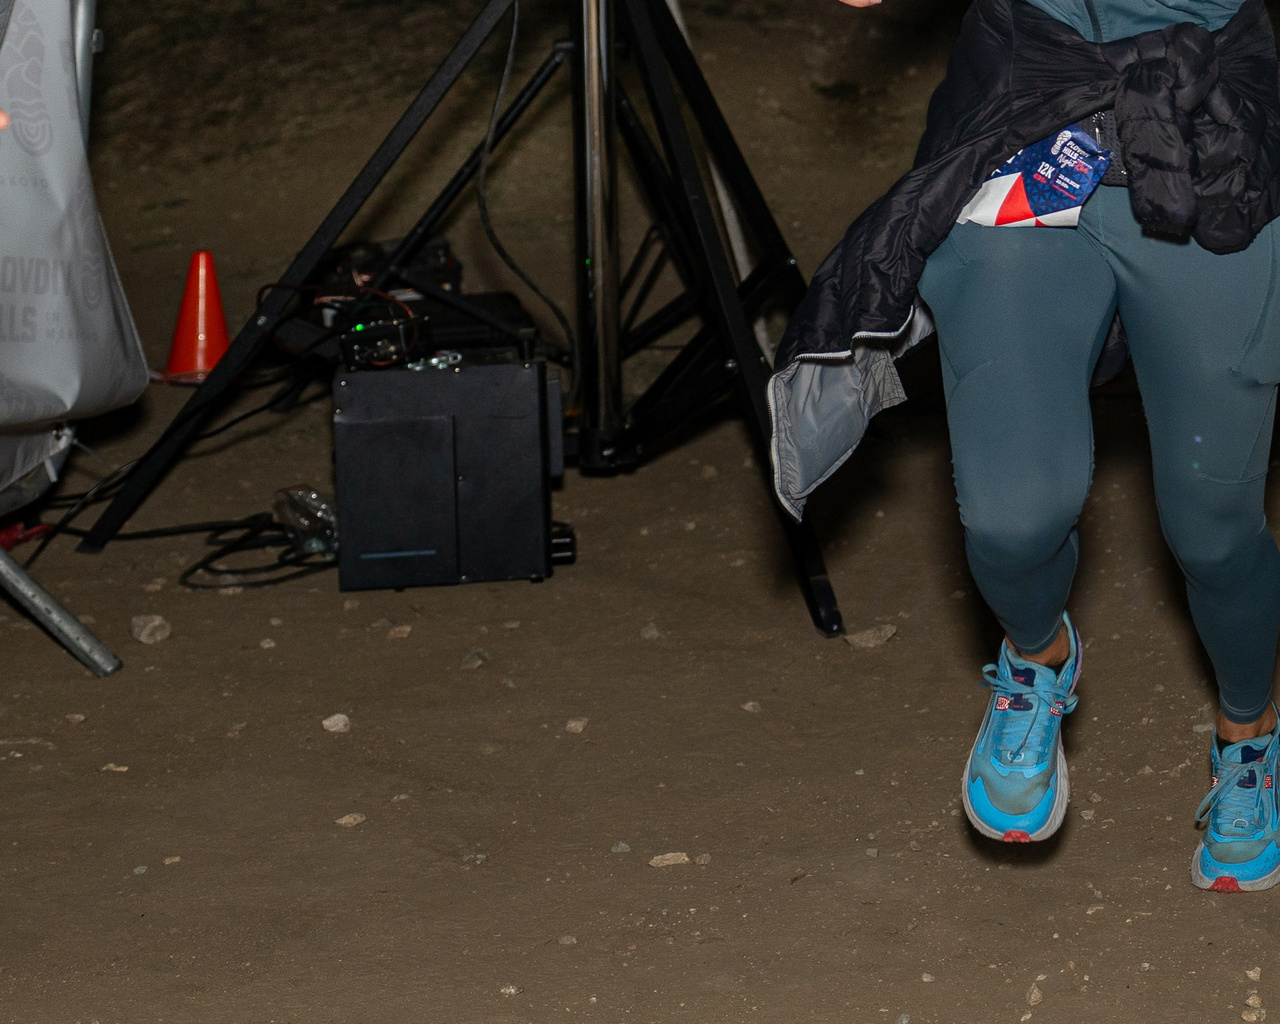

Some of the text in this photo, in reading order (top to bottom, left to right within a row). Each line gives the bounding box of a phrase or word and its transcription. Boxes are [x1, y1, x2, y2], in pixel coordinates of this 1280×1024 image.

[1062, 147, 1078, 159] HILLS
[1037, 161, 1055, 178] 12K
[0, 256, 72, 295] OVDIV
[0, 303, 37, 343] LLS
